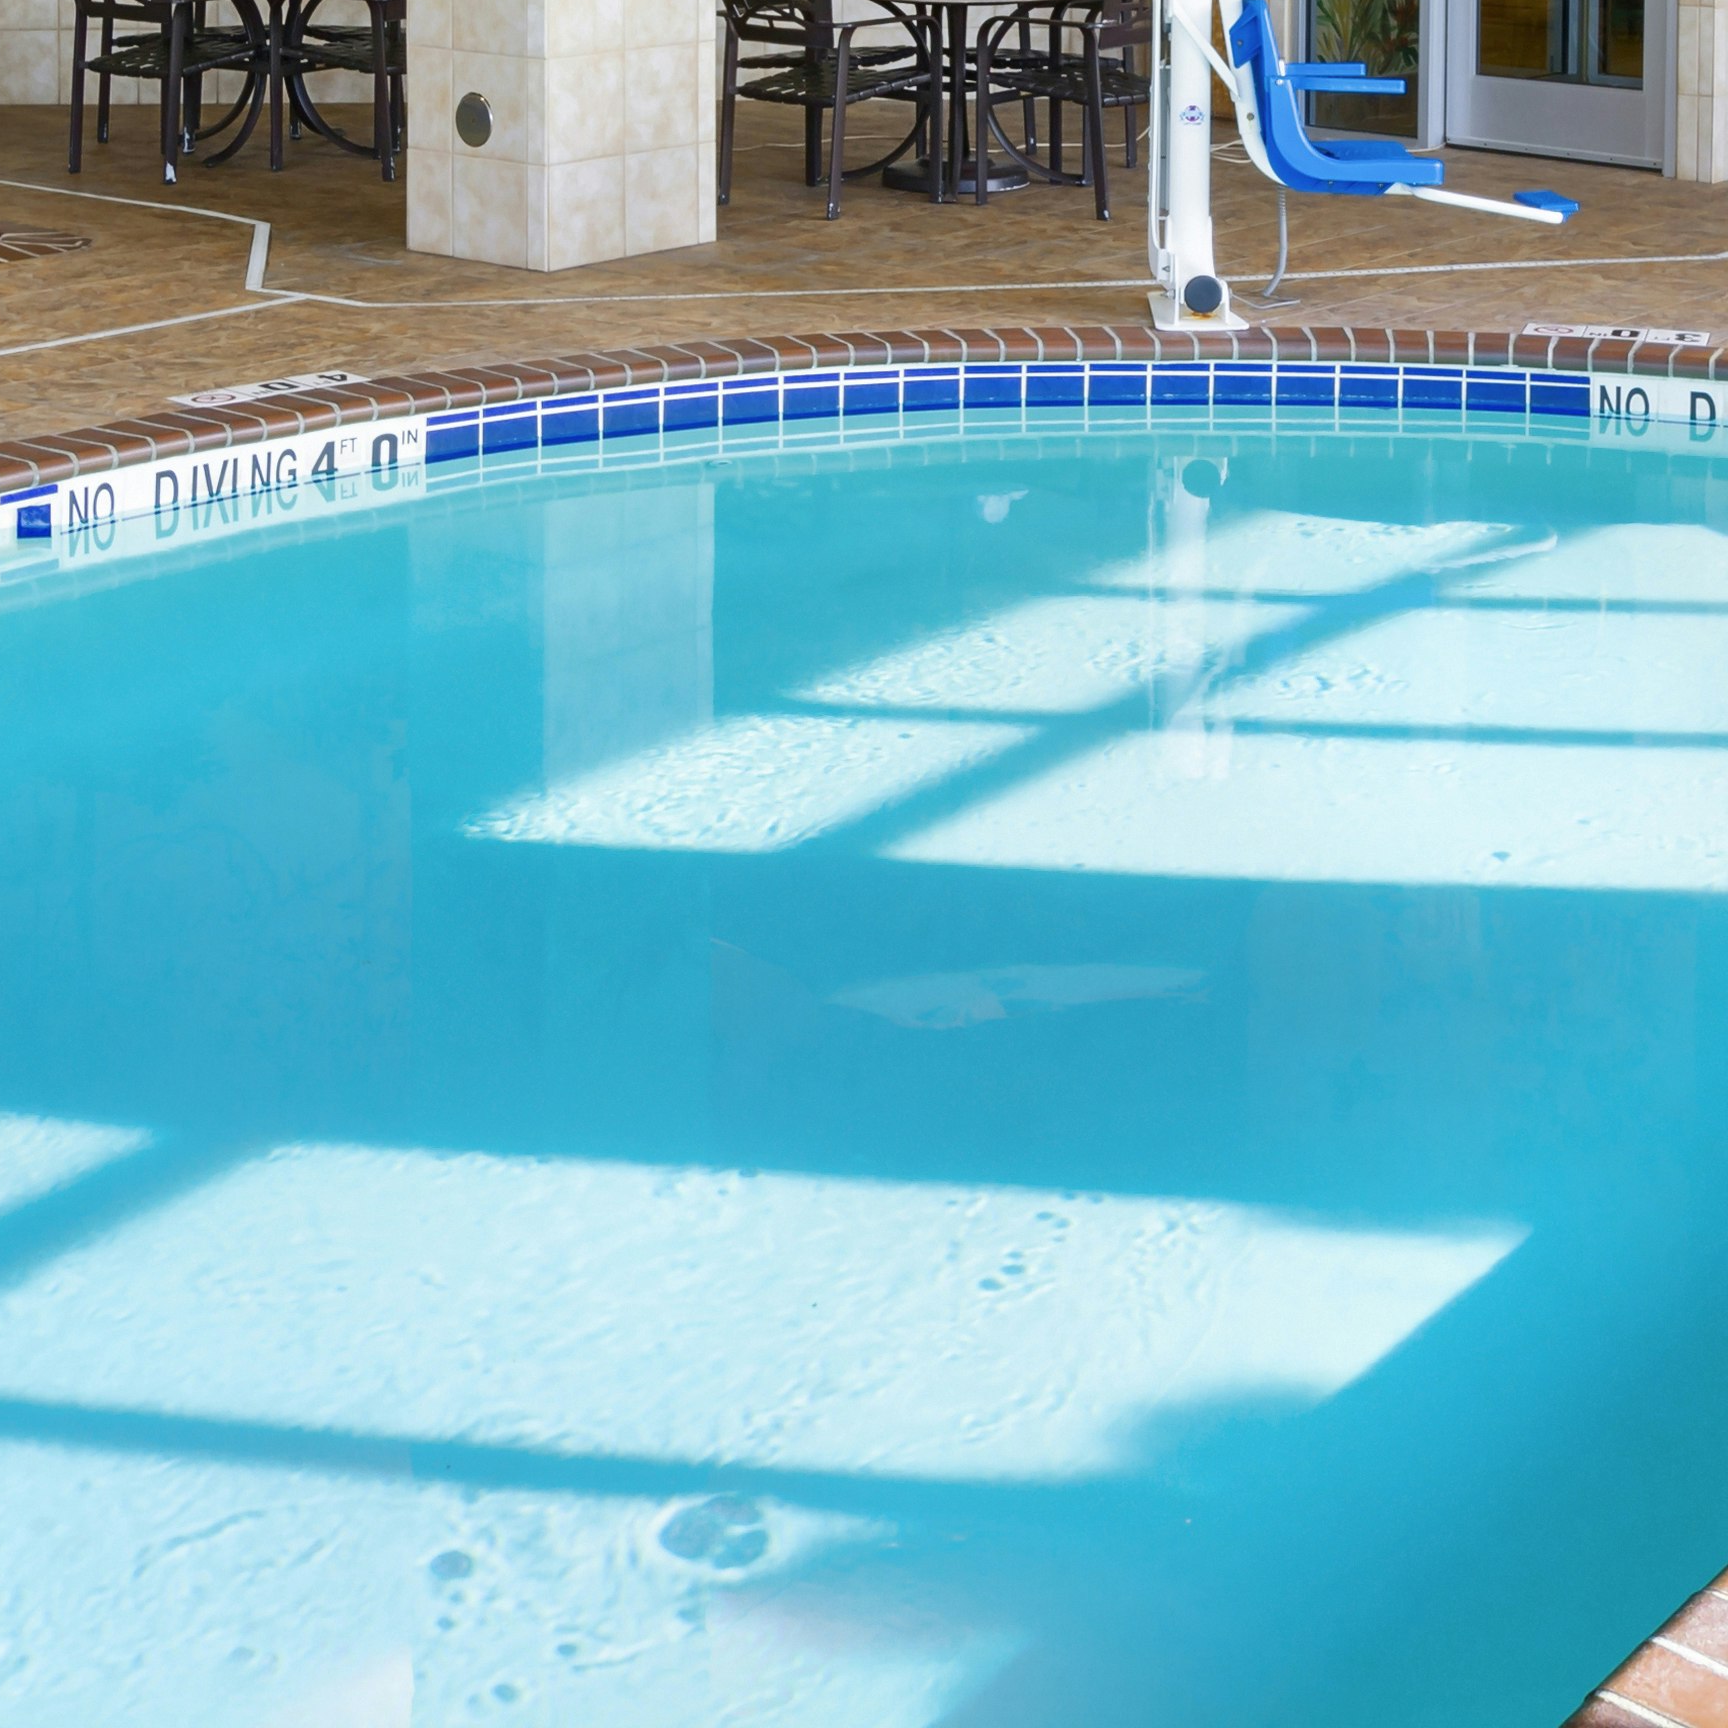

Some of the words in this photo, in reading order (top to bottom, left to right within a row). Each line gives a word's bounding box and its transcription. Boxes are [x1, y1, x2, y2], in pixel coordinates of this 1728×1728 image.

[1599, 385, 1650, 417] NO
[69, 482, 114, 527] NO
[154, 448, 297, 508] DIVING
[311, 441, 338, 476] 4
[340, 437, 357, 454] FT
[372, 433, 398, 468] 0
[401, 429, 418, 445] IN
